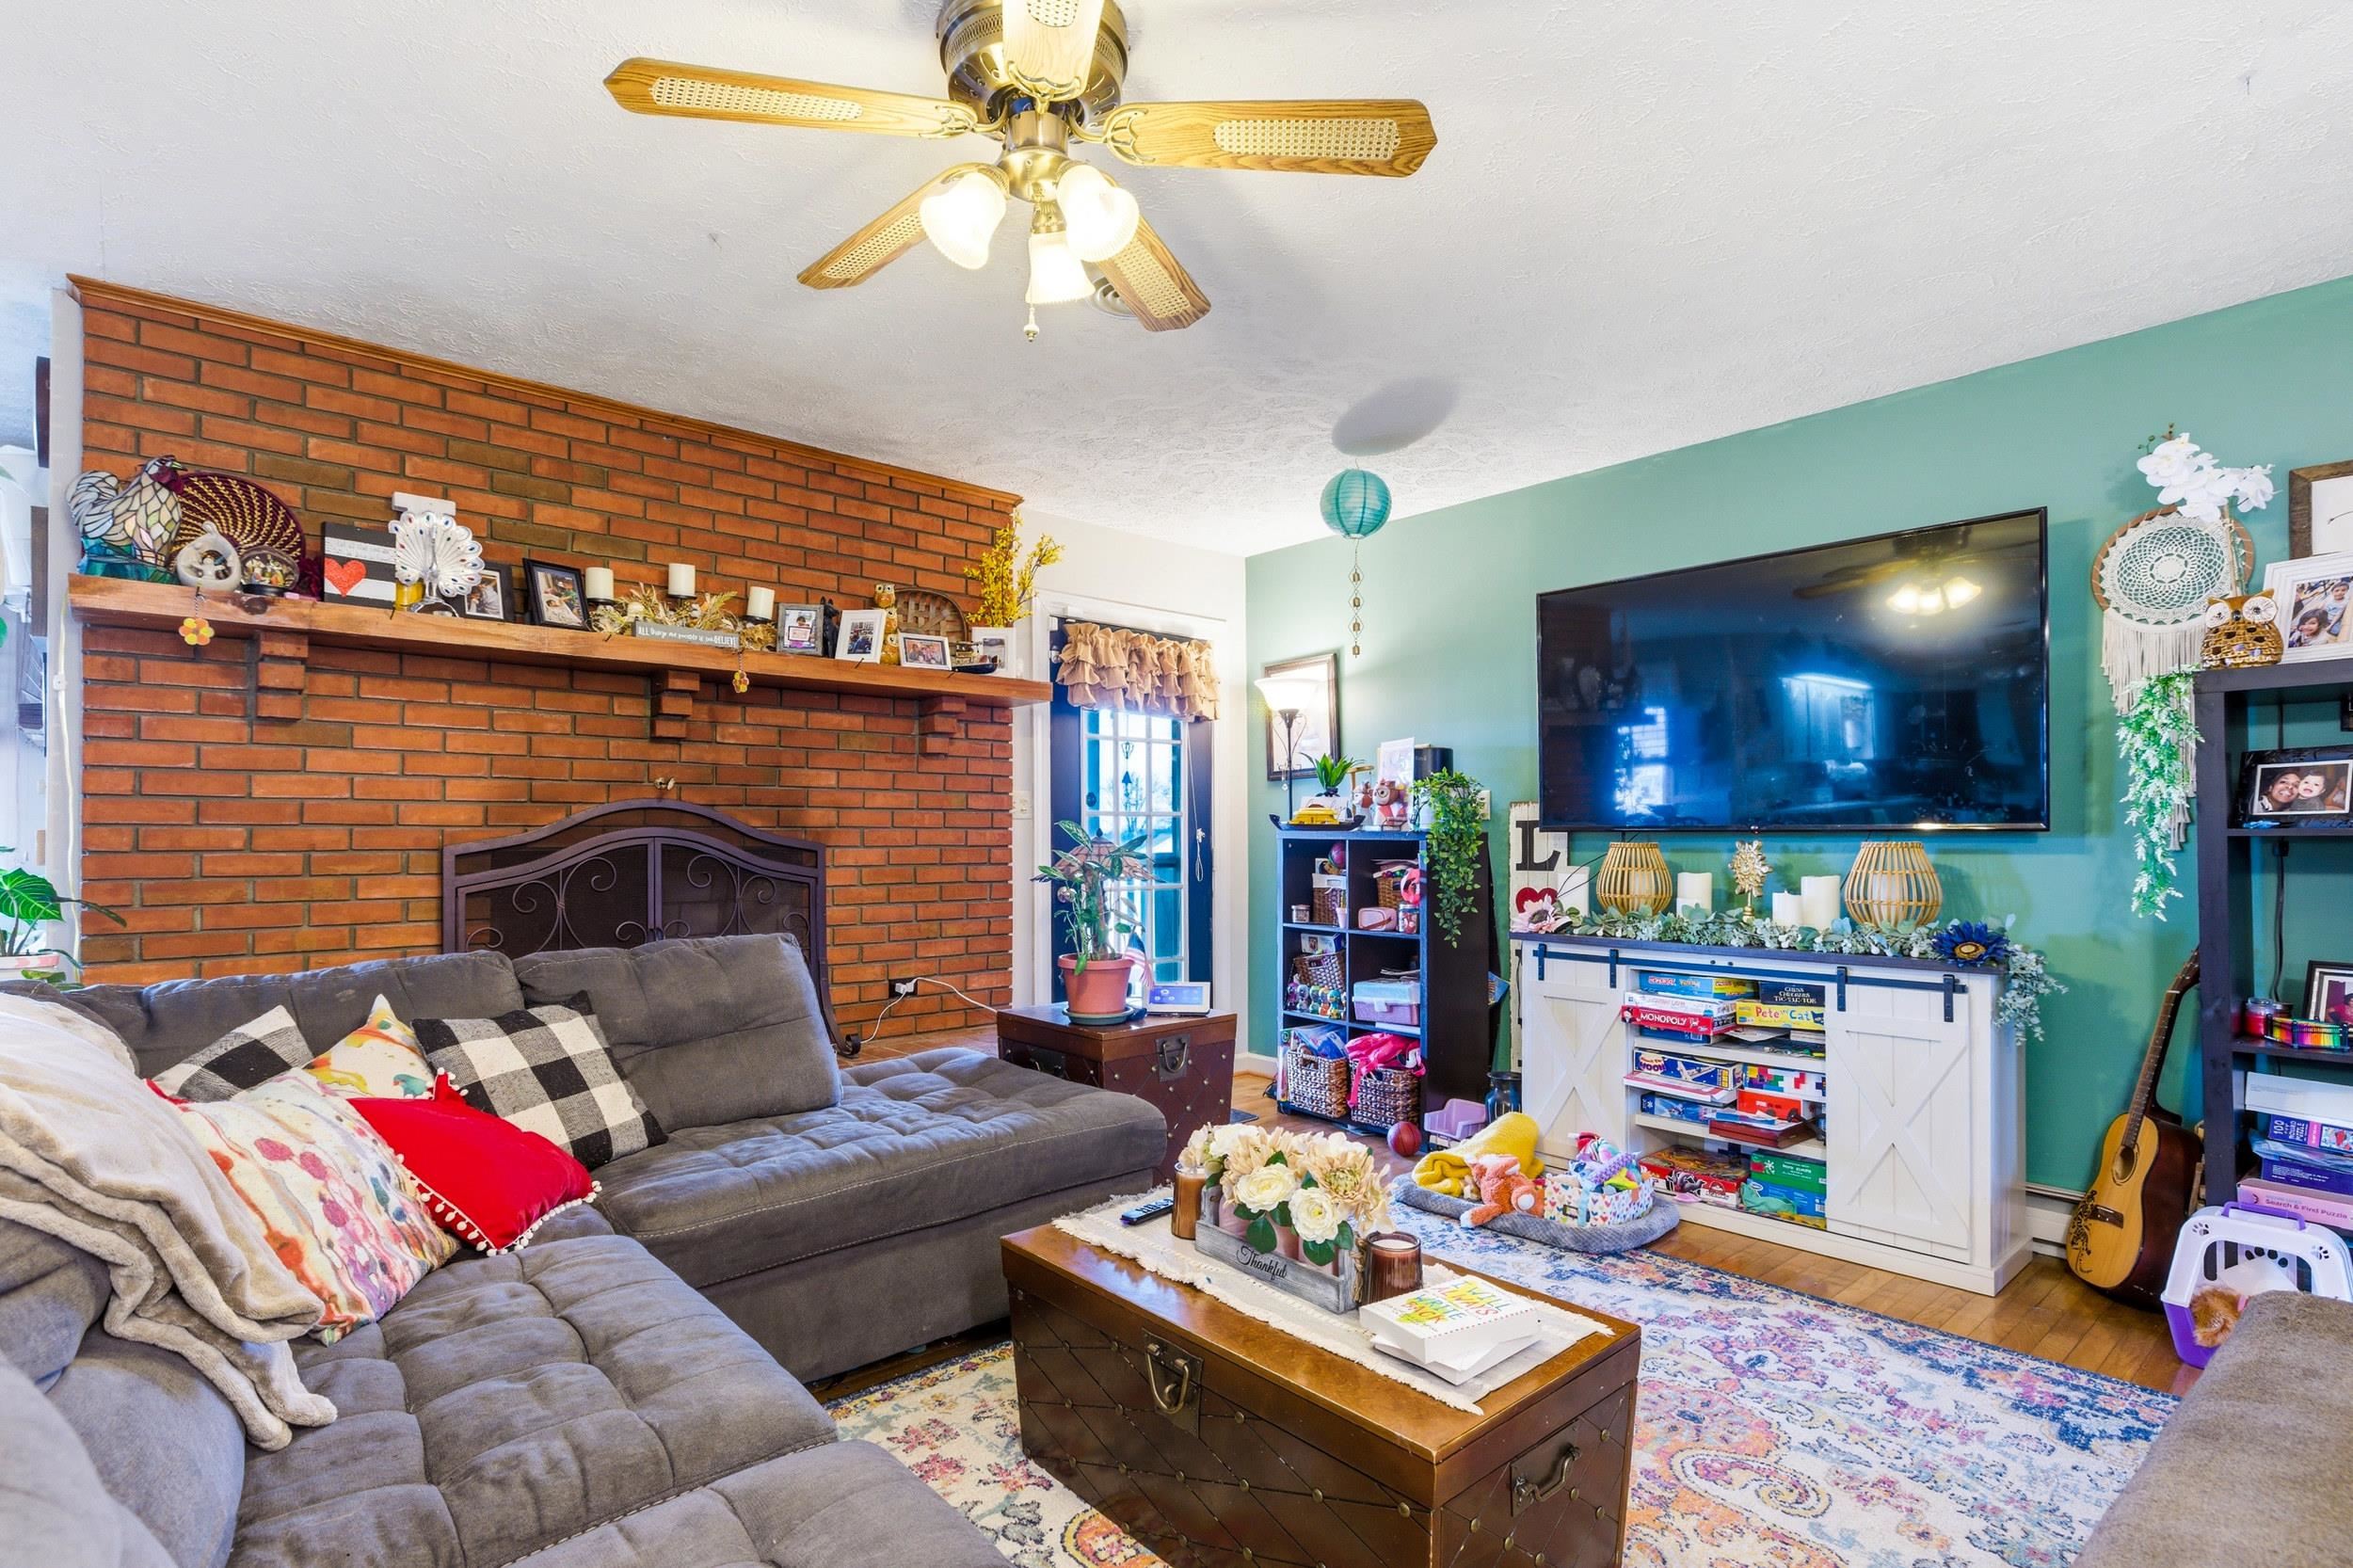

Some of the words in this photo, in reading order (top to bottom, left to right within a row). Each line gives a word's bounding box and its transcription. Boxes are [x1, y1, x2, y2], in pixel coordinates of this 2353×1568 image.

[1641, 1013, 1687, 1026] MONOPOLY
[1755, 1006, 1780, 1018] Pete
[1789, 1010, 1810, 1021] Cat
[2274, 1120, 2284, 1134] 100
[2265, 1199, 2292, 1208] Search
[2301, 1206, 2319, 1214] Find
[2321, 1208, 2347, 1220] Puzzle
[1237, 1245, 1288, 1280] Thankful
